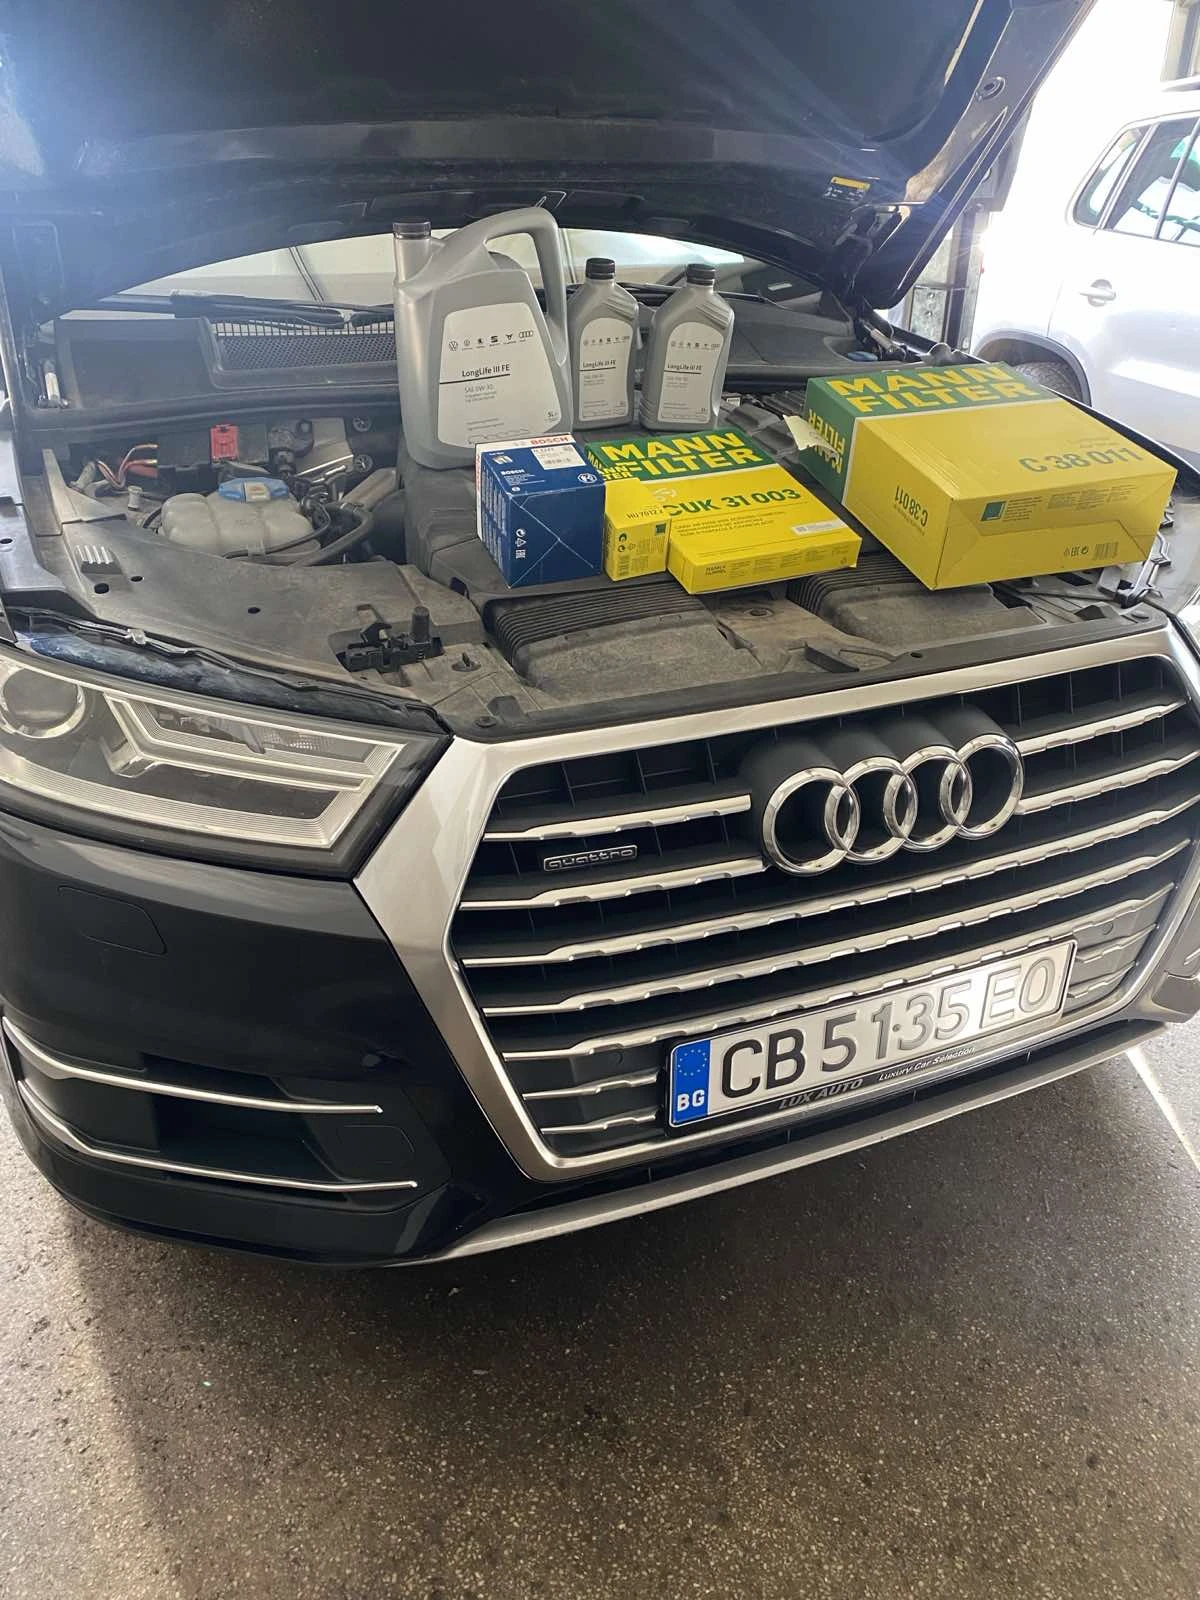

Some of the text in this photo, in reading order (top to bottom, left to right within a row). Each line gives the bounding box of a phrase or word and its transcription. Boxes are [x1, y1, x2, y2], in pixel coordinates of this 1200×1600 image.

[461, 366, 492, 378] LongLife
[501, 363, 510, 372] FE
[583, 360, 604, 369] LongLife
[667, 363, 690, 371] LongLife
[826, 366, 1013, 396] MANN
[847, 381, 1040, 413] FILTER
[530, 436, 569, 446] BOSCH
[600, 432, 746, 462] MANN
[1018, 458, 1048, 472] C
[721, 495, 751, 508] 31
[751, 488, 801, 504] 003
[920, 509, 929, 527] C
[548, 848, 633, 868] quattro
[721, 1029, 806, 1099] CB
[778, 1047, 976, 1110] LUX AUTO Luxury Car Selection
[677, 1088, 705, 1112] BG
